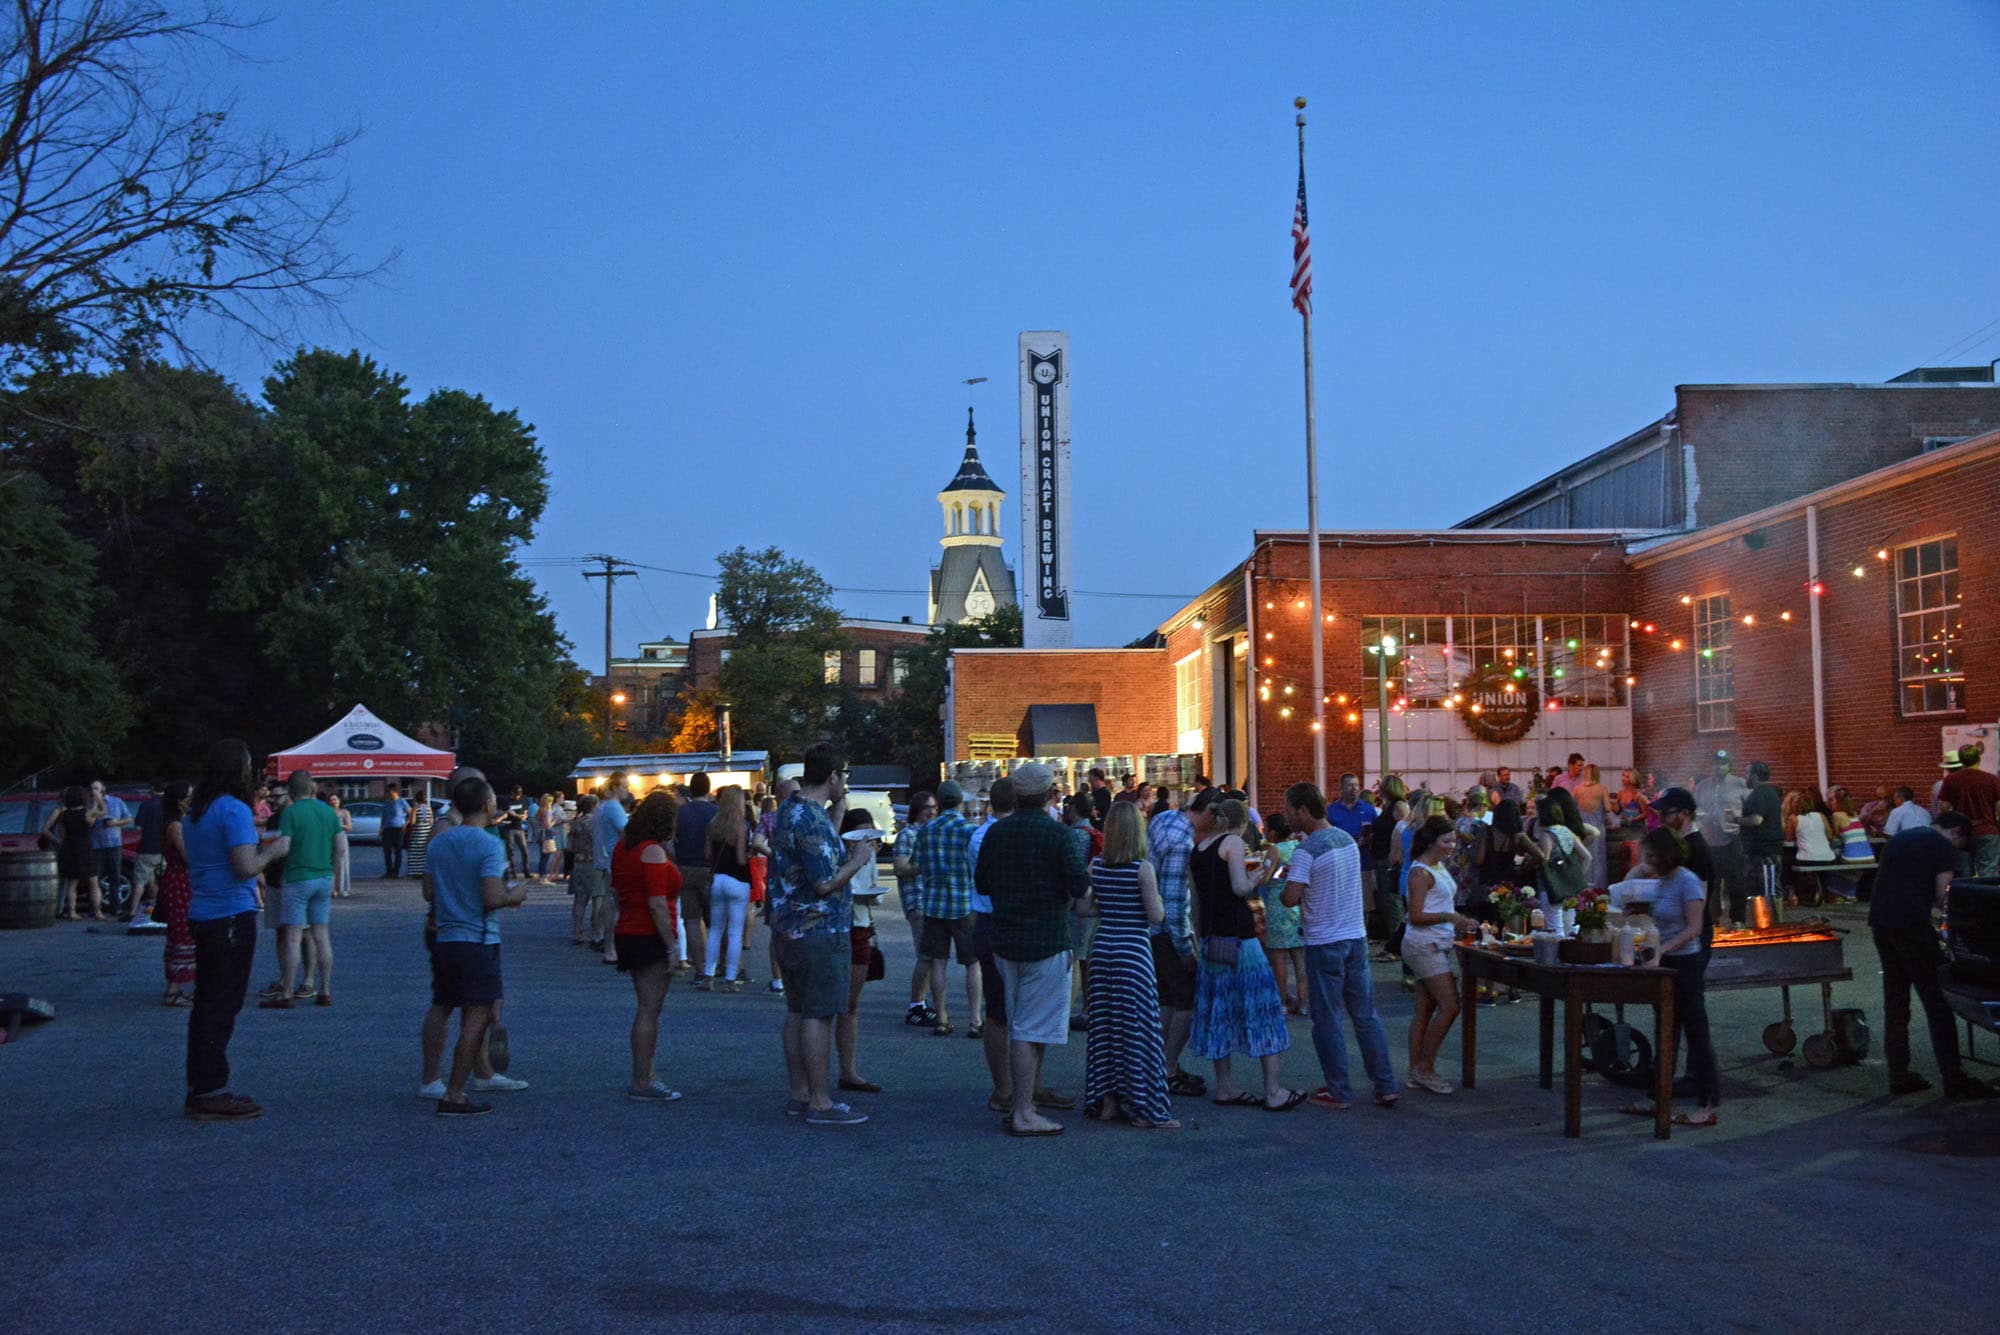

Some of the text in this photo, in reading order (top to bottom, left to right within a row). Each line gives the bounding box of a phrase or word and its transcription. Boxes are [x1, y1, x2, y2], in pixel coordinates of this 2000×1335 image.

[1041, 368, 1049, 377] U
[1040, 395, 1053, 599] UNION CRAFT BREWING
[1472, 691, 1527, 705] UNION
